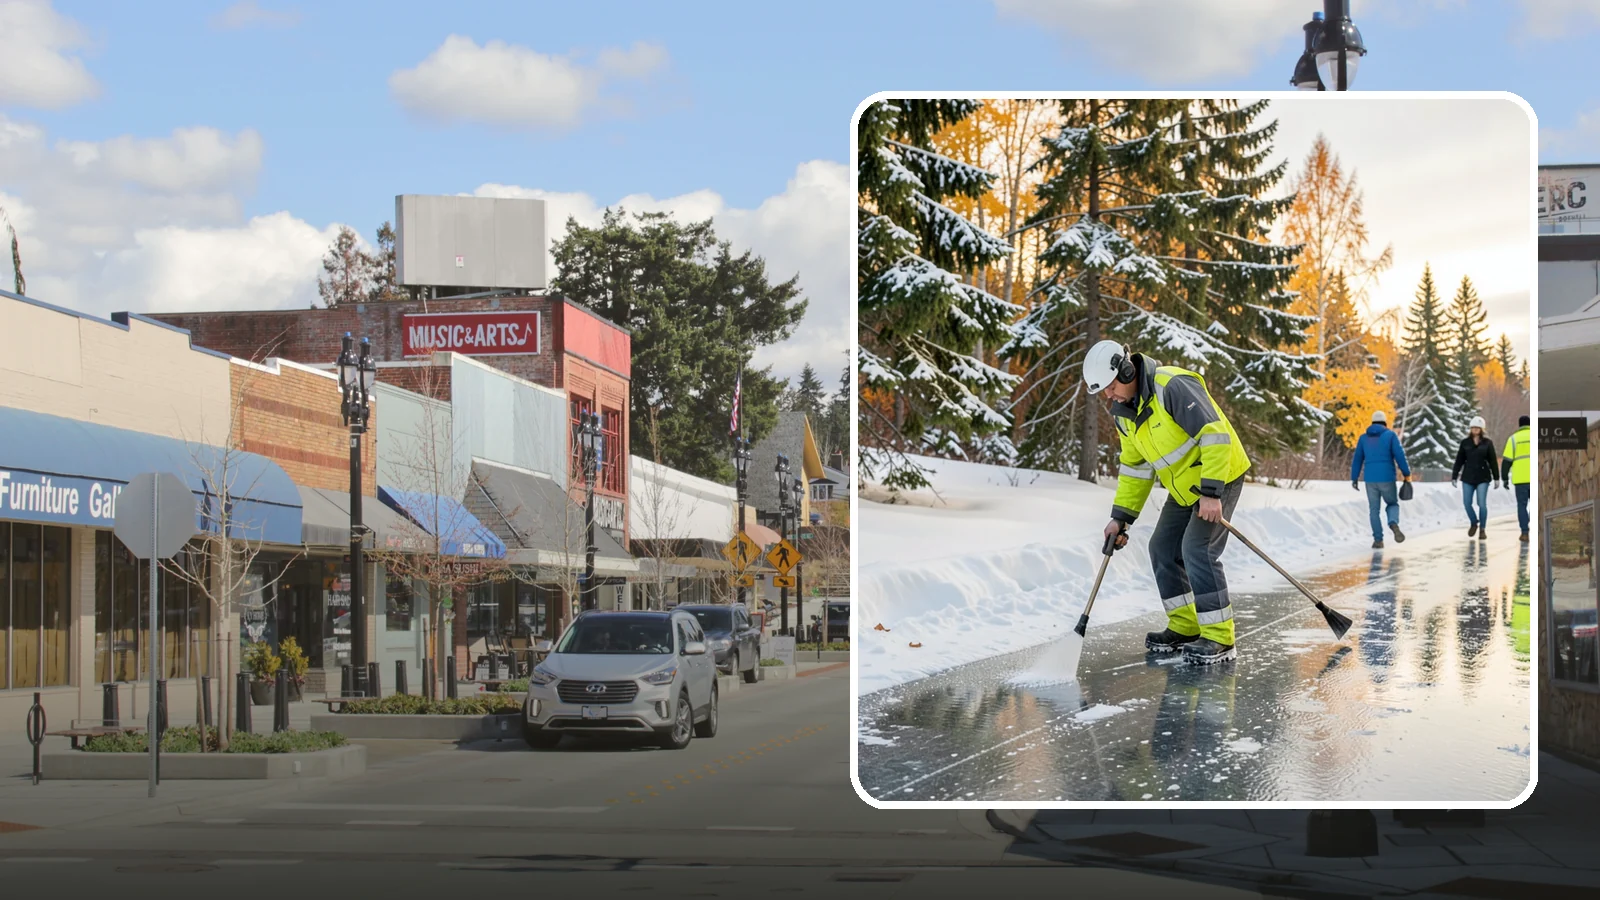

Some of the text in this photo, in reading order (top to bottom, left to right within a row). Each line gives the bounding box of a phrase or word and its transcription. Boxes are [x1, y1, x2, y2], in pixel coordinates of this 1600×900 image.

[408, 323, 518, 349] MUSIC&ARTS
[0, 471, 122, 518] Furniture Gal
